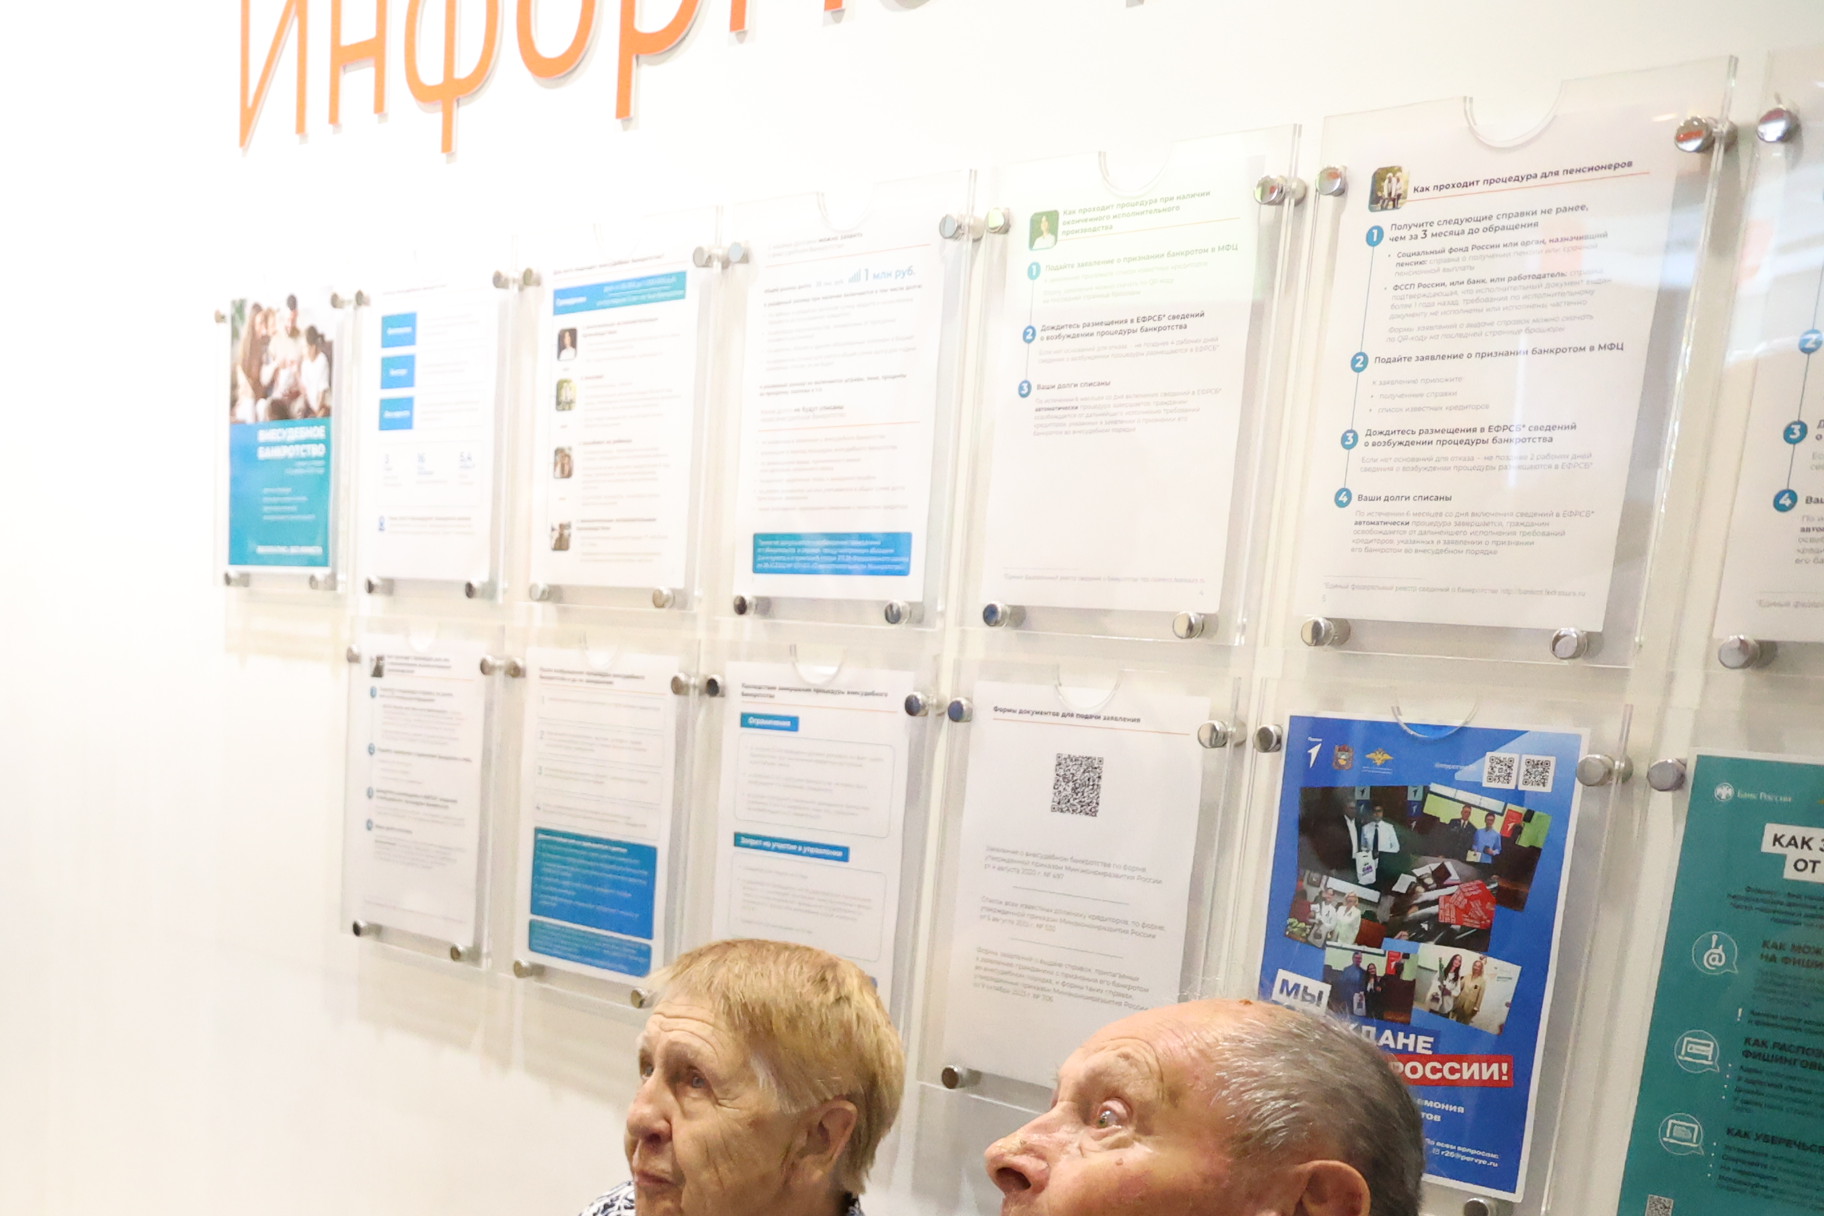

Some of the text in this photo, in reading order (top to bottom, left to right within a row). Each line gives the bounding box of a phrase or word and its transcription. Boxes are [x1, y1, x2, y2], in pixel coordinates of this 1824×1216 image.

[239, 0, 844, 152] Инфор
[1412, 160, 1634, 193] Как проходит процедура для пенсионеров
[1372, 203, 1589, 242] 1 Получите следующие справки не ранее,
[1388, 219, 1539, 243] чем за 3 месяца до обращения
[1032, 266, 1036, 276] 1
[1026, 329, 1033, 340] 2
[1355, 356, 1363, 368] 2
[1373, 353, 1413, 365] Подайте
[1414, 352, 1464, 362] заявление
[1473, 348, 1529, 359] признании
[1530, 344, 1587, 356] банкротом
[1588, 344, 1595, 352] в
[1596, 341, 1625, 352] МФЦ
[1021, 384, 1028, 394] 3
[1345, 433, 1354, 445] 3
[1364, 427, 1417, 437] Дождитесь
[1417, 426, 1478, 435] размещения
[1527, 422, 1577, 432] сведений
[1790, 425, 1800, 438] 3
[1370, 438, 1434, 448] возбуждении
[1434, 437, 1490, 447] процедуры
[1490, 434, 1554, 444] банкротства
[1338, 492, 1348, 503] 4
[1356, 493, 1382, 502] Ваши
[1779, 494, 1791, 506] 4
[1737, 791, 1792, 802] Банк России
[1772, 833, 1814, 850] КАК
[1793, 858, 1821, 874] ОТ
[1279, 977, 1324, 1007] МЫ
[1744, 1037, 1768, 1048] КАК
[1727, 1127, 1751, 1140] КАК
